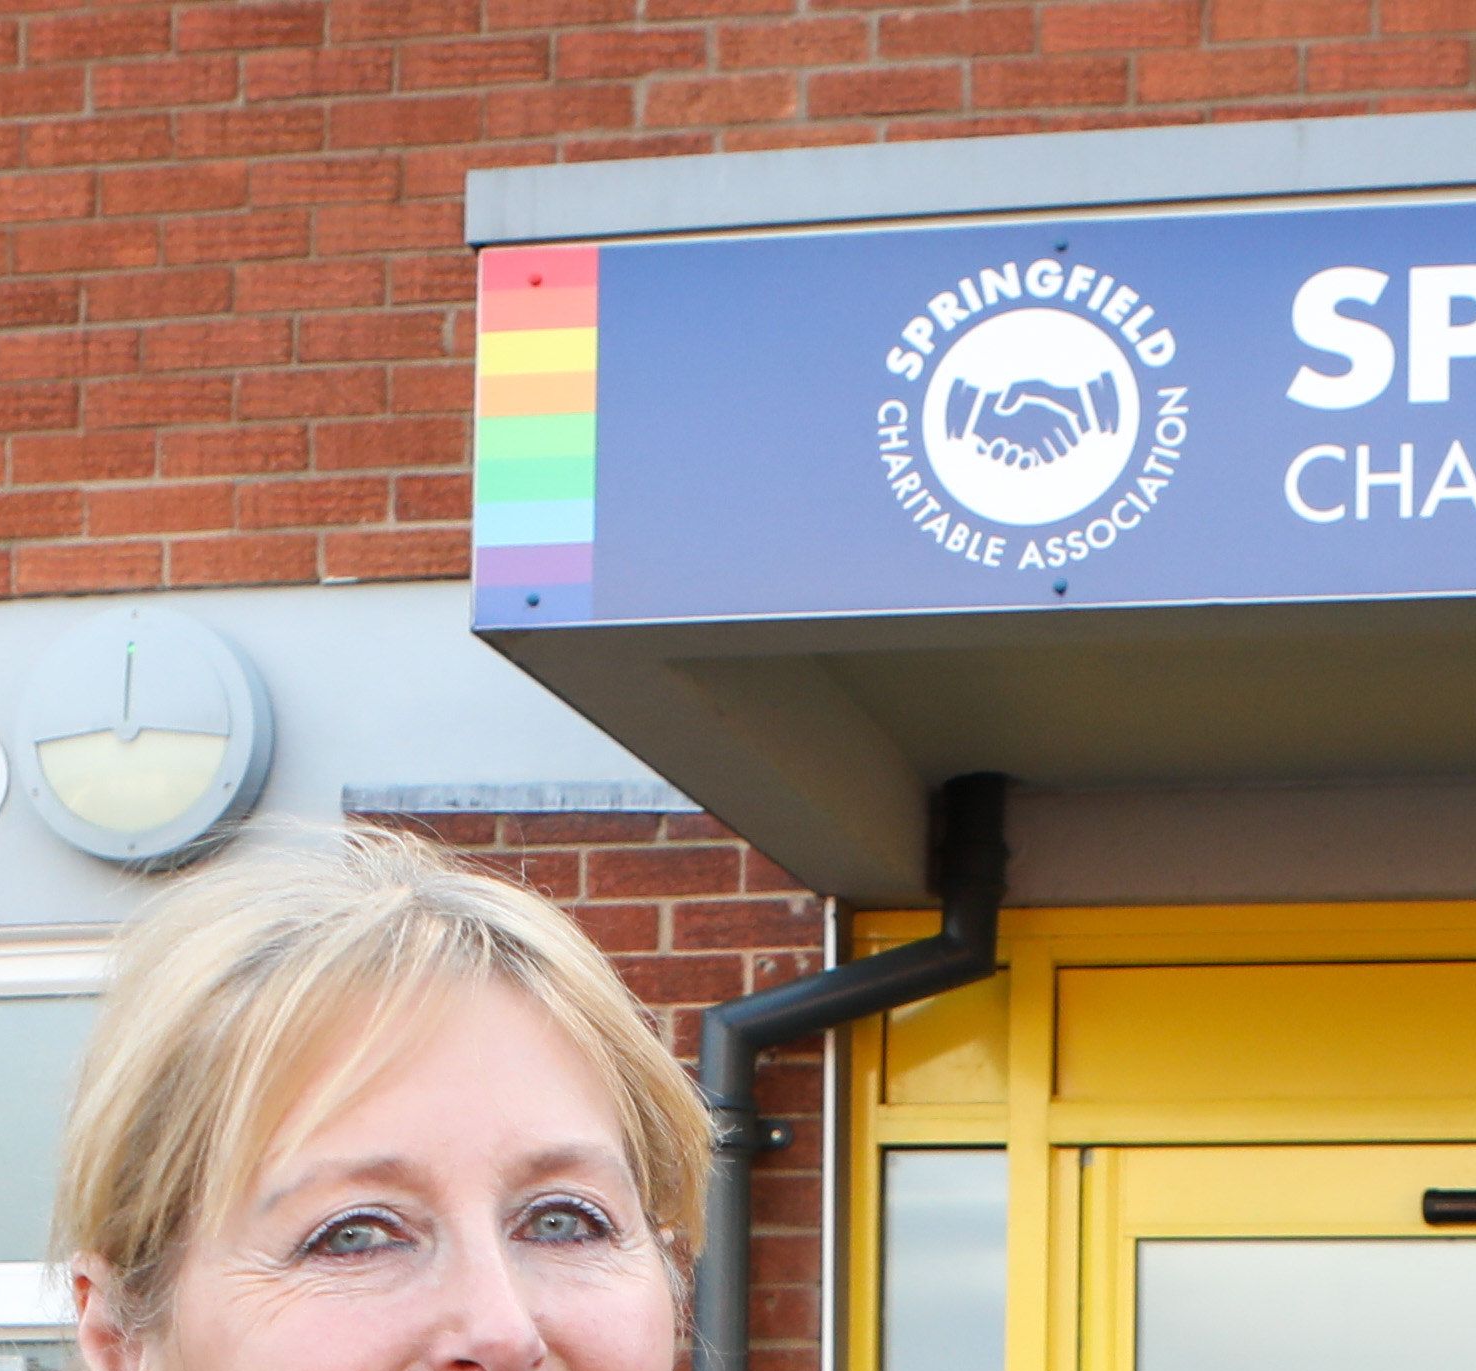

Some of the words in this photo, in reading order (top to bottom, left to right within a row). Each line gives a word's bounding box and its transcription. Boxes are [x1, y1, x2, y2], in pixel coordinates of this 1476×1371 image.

[885, 258, 1176, 382] SPRINGFIELD
[877, 399, 1007, 567] CHARITABLE
[1017, 386, 1190, 570] ASSOCIATION
